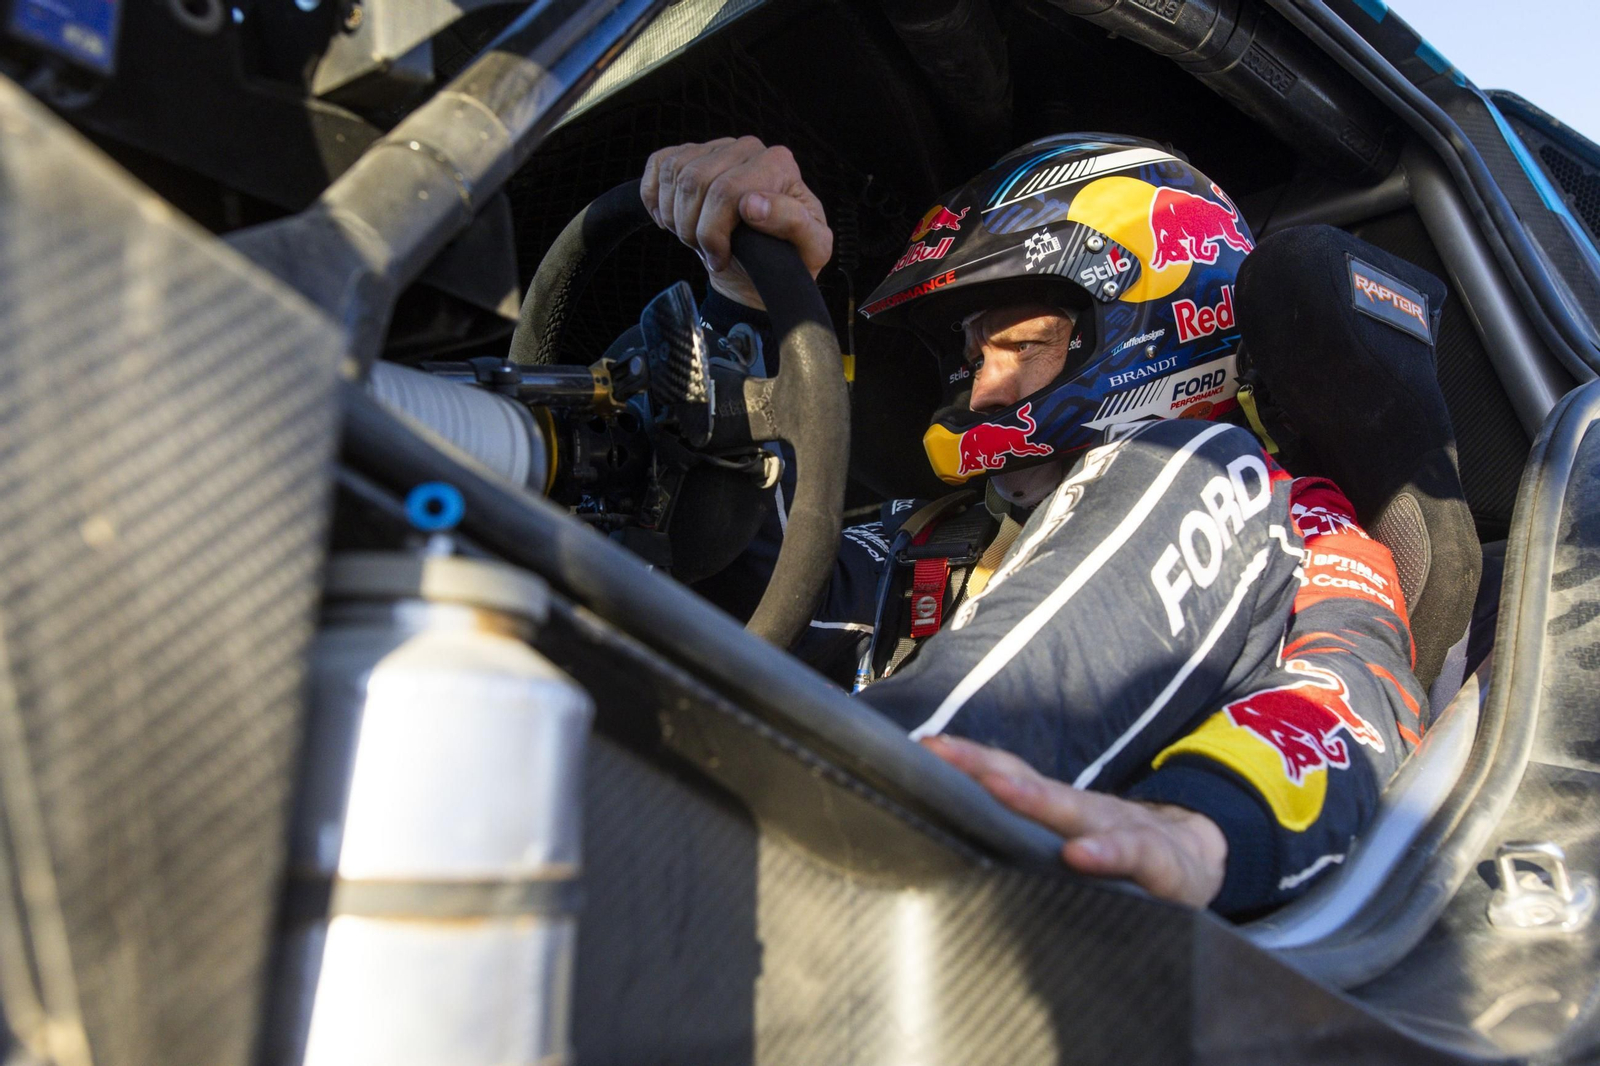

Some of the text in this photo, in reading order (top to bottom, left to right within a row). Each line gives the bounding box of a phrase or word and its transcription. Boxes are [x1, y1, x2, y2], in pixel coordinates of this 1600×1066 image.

[1080, 253, 1131, 287] Stilo
[865, 270, 956, 315] PERFORMANCE
[1354, 272, 1427, 330] RAPTOR
[1172, 284, 1236, 343] Red
[1108, 355, 1178, 388] BRANDT
[1171, 368, 1227, 402] FORD
[1170, 385, 1225, 411] PERFORMANCE
[1150, 453, 1272, 638] FORD
